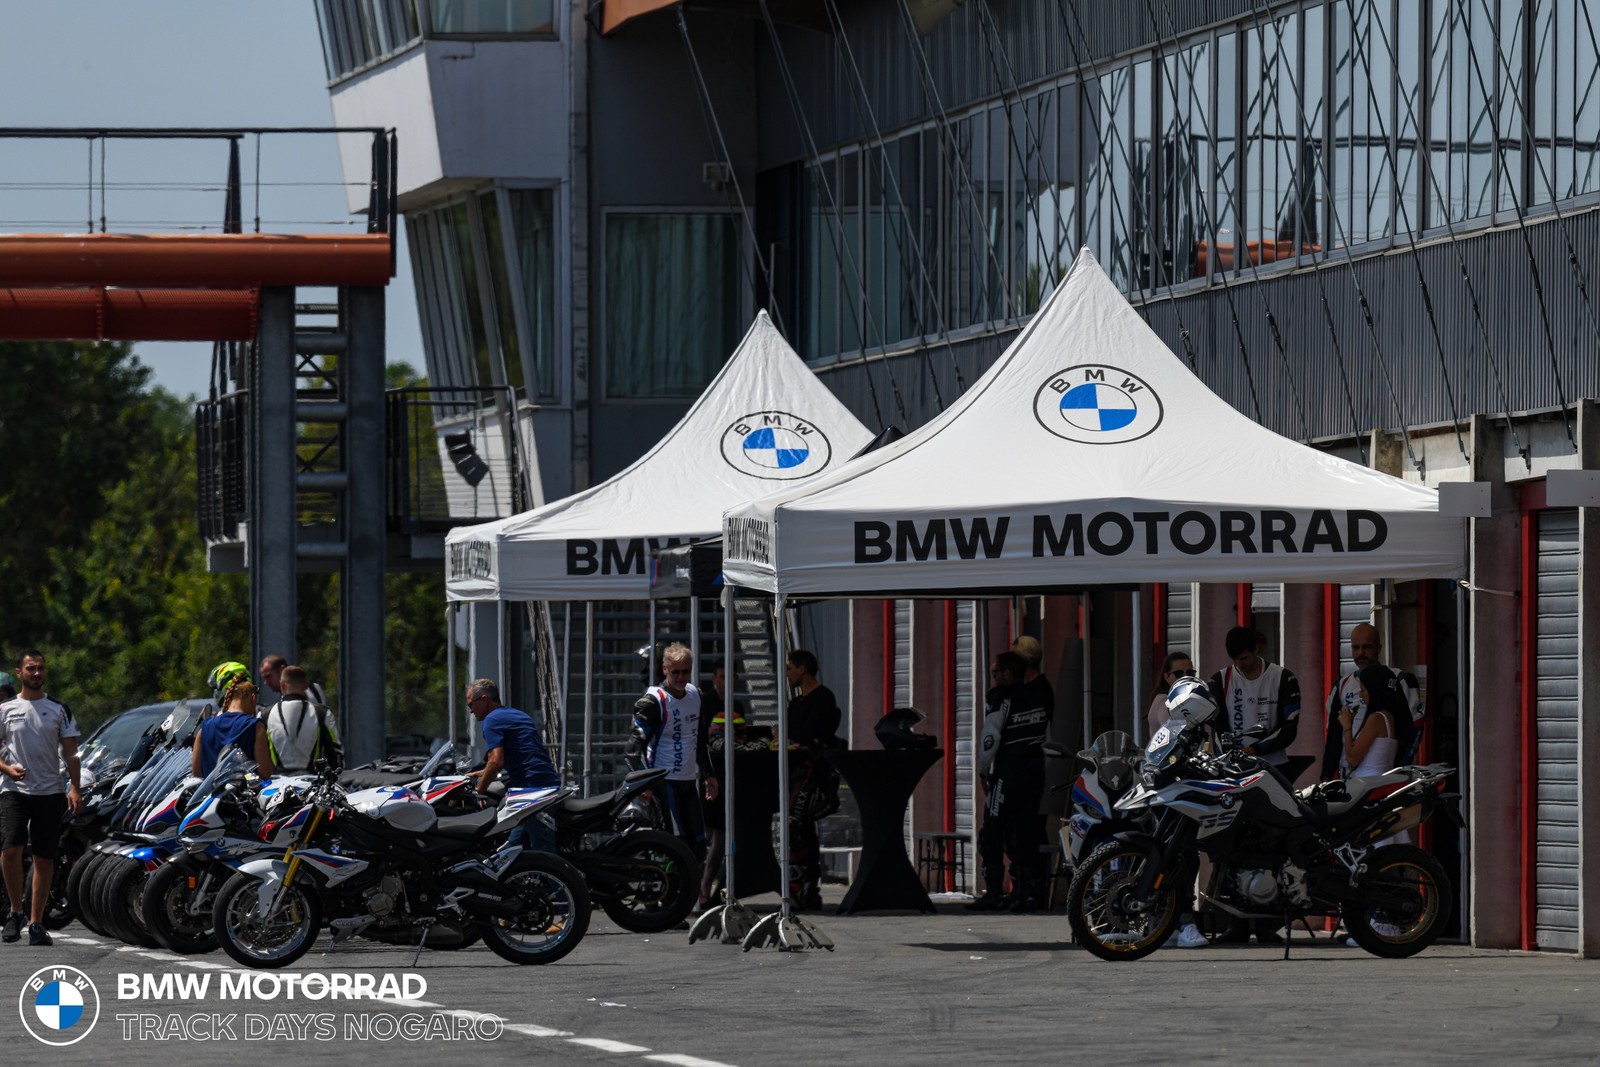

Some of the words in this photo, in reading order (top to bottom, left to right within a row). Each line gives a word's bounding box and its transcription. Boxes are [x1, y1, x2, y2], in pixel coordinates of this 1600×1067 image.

[1049, 369, 1143, 394] BMW
[734, 415, 814, 436] BMW
[854, 516, 1010, 563] BMW
[1032, 509, 1388, 557] MOTORRAD
